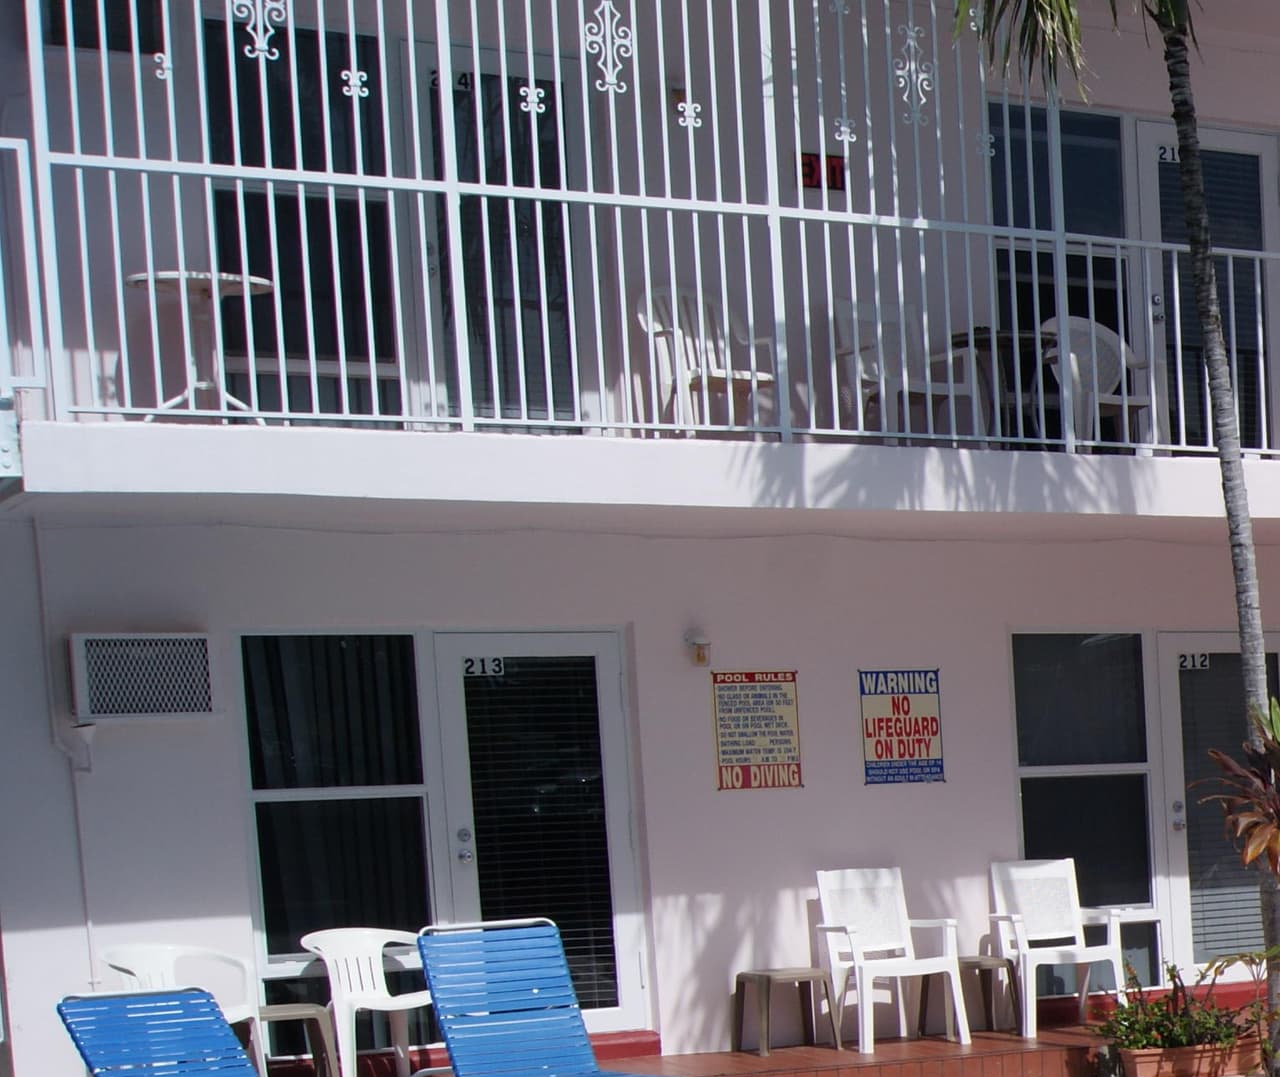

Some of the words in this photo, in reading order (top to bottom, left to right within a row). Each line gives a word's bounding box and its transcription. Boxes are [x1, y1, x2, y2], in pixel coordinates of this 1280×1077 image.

[430, 70, 469, 89] 24
[1159, 146, 1181, 162] 21
[464, 658, 503, 674] 213
[1180, 654, 1208, 668] 212
[717, 674, 749, 682] POOL
[755, 673, 793, 681] RULES
[862, 672, 937, 693] WARNING
[892, 696, 910, 716] NO
[865, 717, 939, 738] LIFEGUARD
[875, 739, 894, 759] ON
[898, 738, 931, 758] DUTY
[722, 766, 743, 788] NO
[751, 765, 800, 788] DIVING
